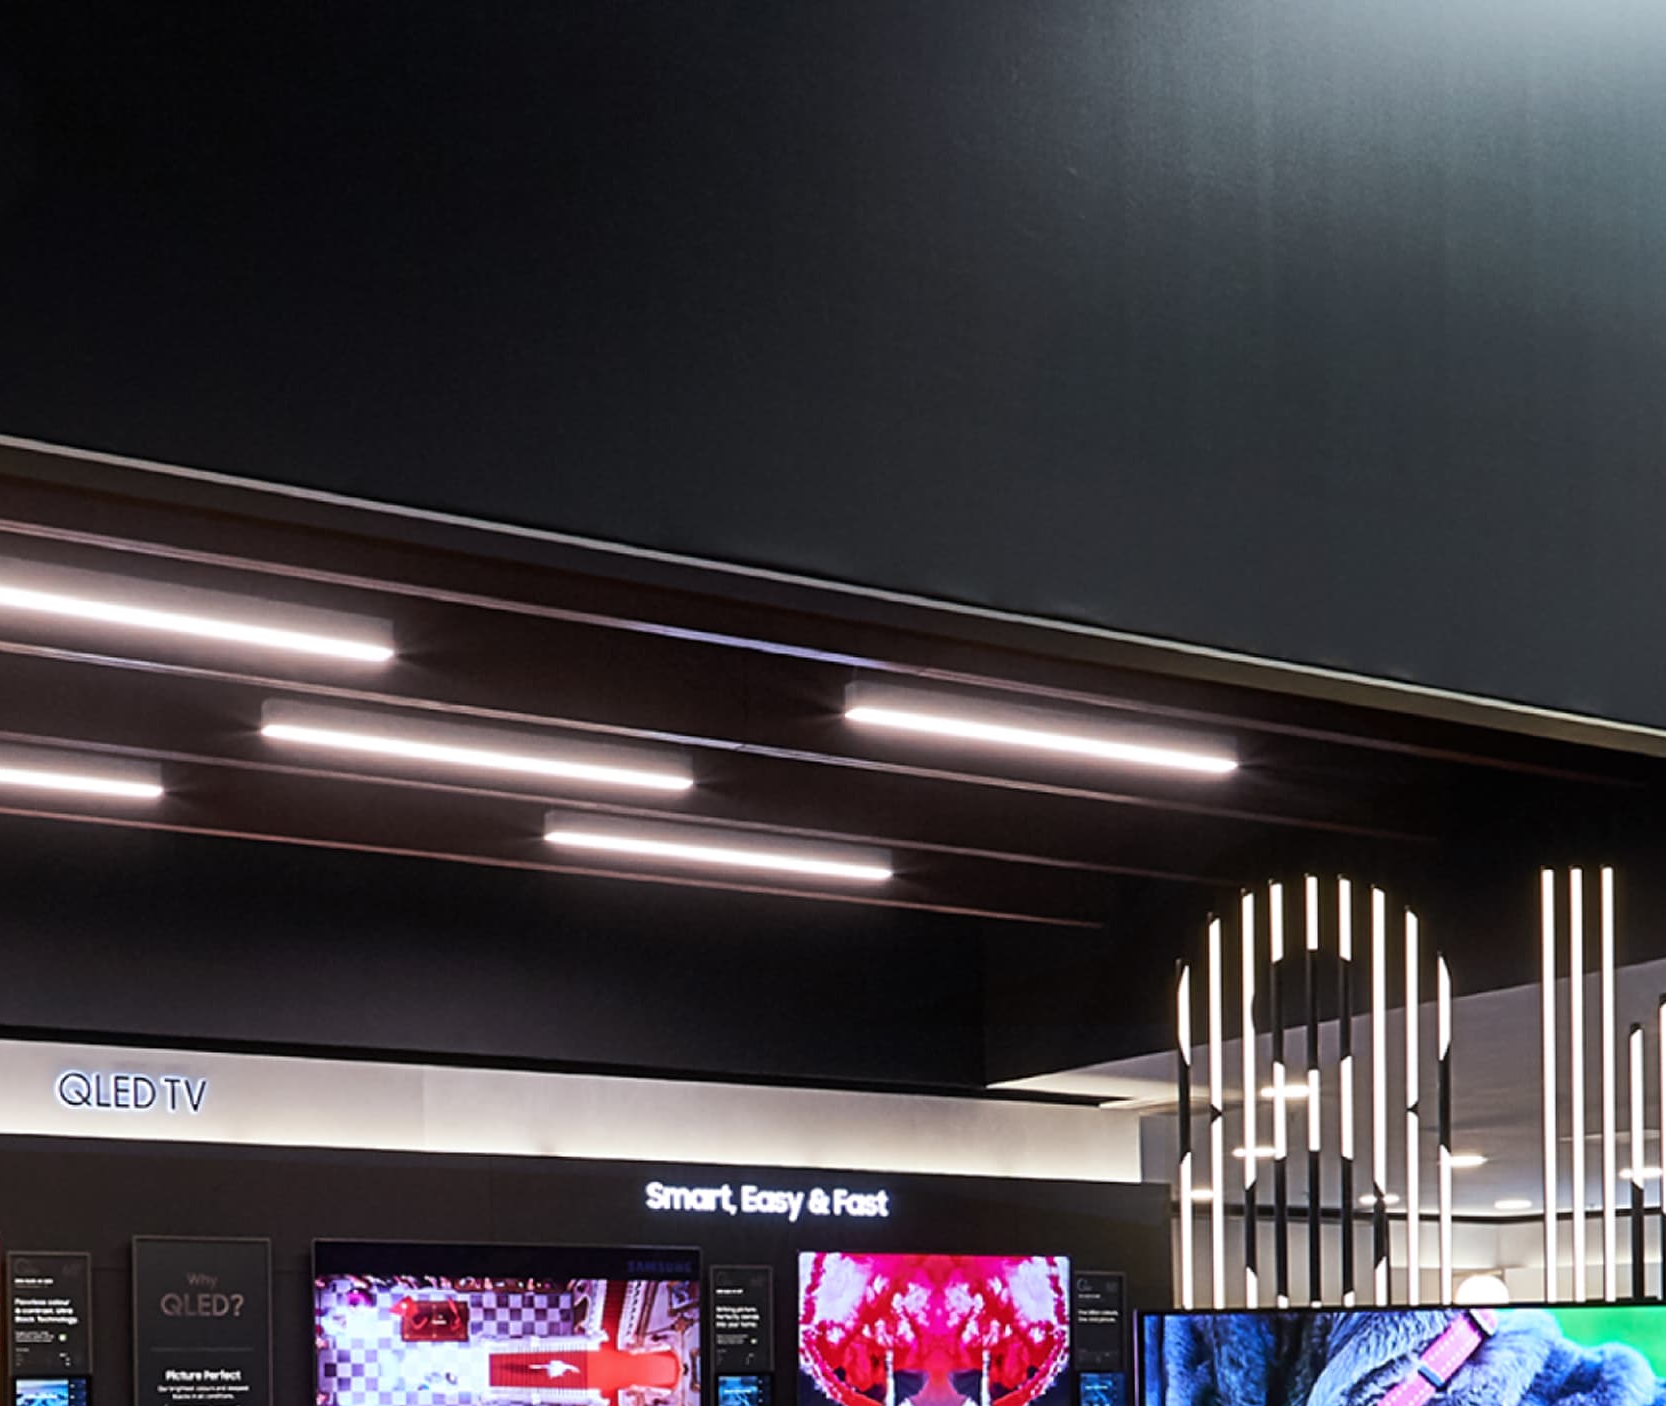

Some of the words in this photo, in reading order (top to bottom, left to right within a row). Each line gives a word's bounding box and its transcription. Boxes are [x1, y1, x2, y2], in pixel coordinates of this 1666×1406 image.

[59, 1072, 156, 1109] QLED
[164, 1078, 206, 1111] TV
[645, 1181, 737, 1215] Smart,
[741, 1185, 804, 1222] Easy
[807, 1188, 830, 1215] &
[833, 1189, 889, 1217] Fast
[187, 1273, 218, 1288] Why
[160, 1293, 244, 1317] QLED?
